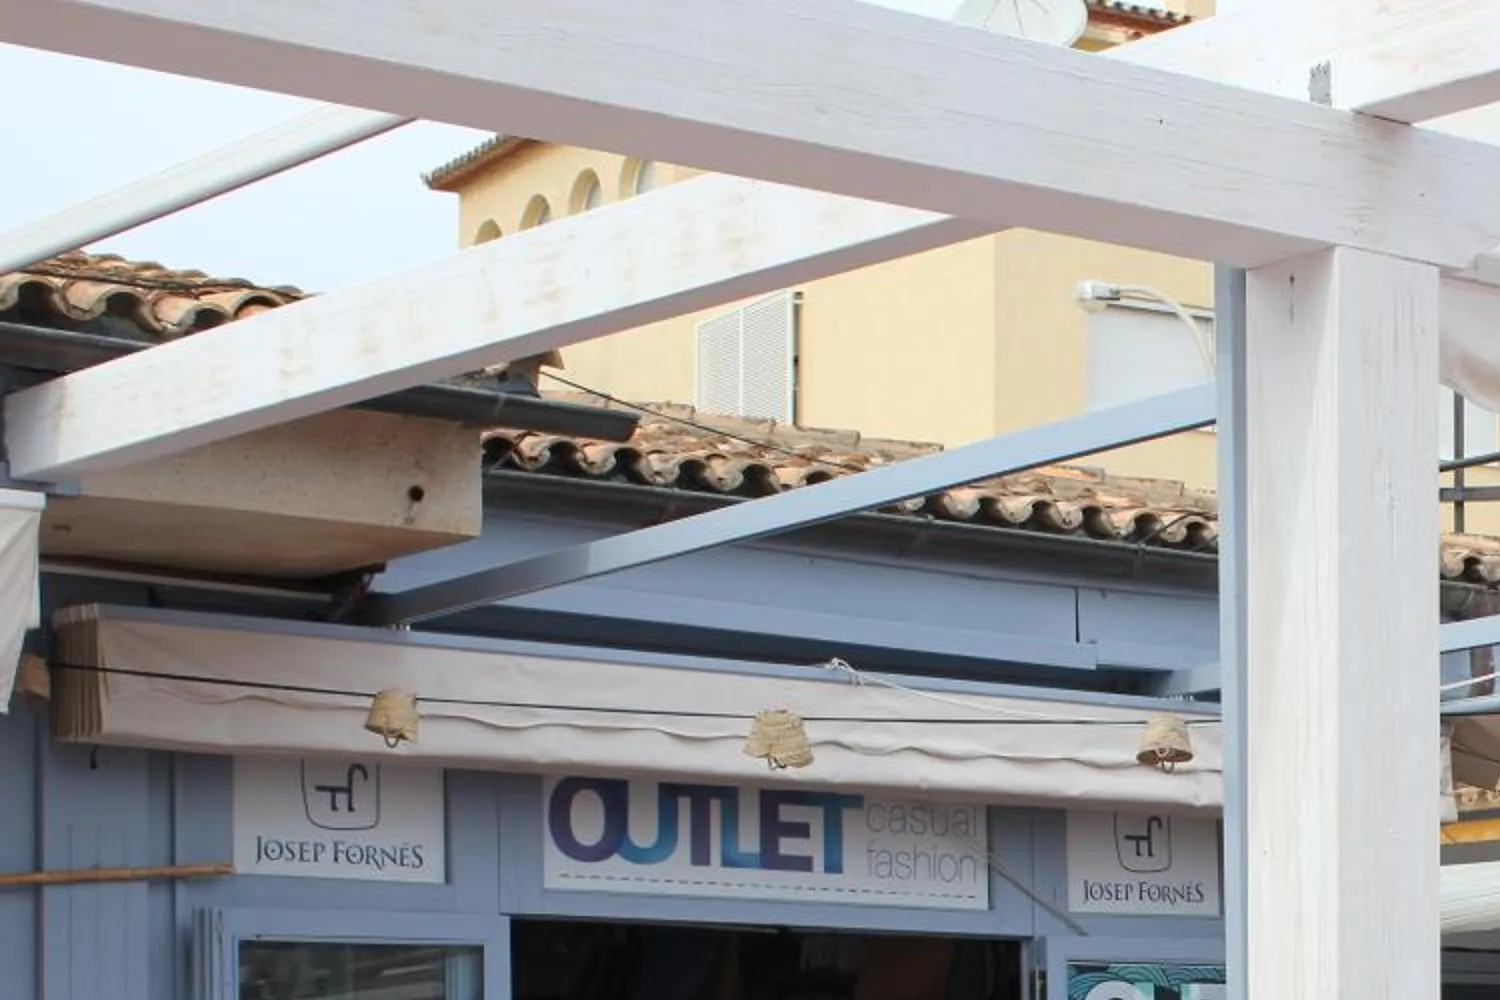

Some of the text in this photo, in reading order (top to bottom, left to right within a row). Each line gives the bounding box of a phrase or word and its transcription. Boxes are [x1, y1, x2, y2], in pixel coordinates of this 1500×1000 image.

[549, 776, 863, 875] OUTLET
[866, 797, 979, 837] casual
[255, 836, 326, 865] JOSEP
[867, 841, 980, 884] fashion
[1083, 879, 1133, 904] JOSEP
